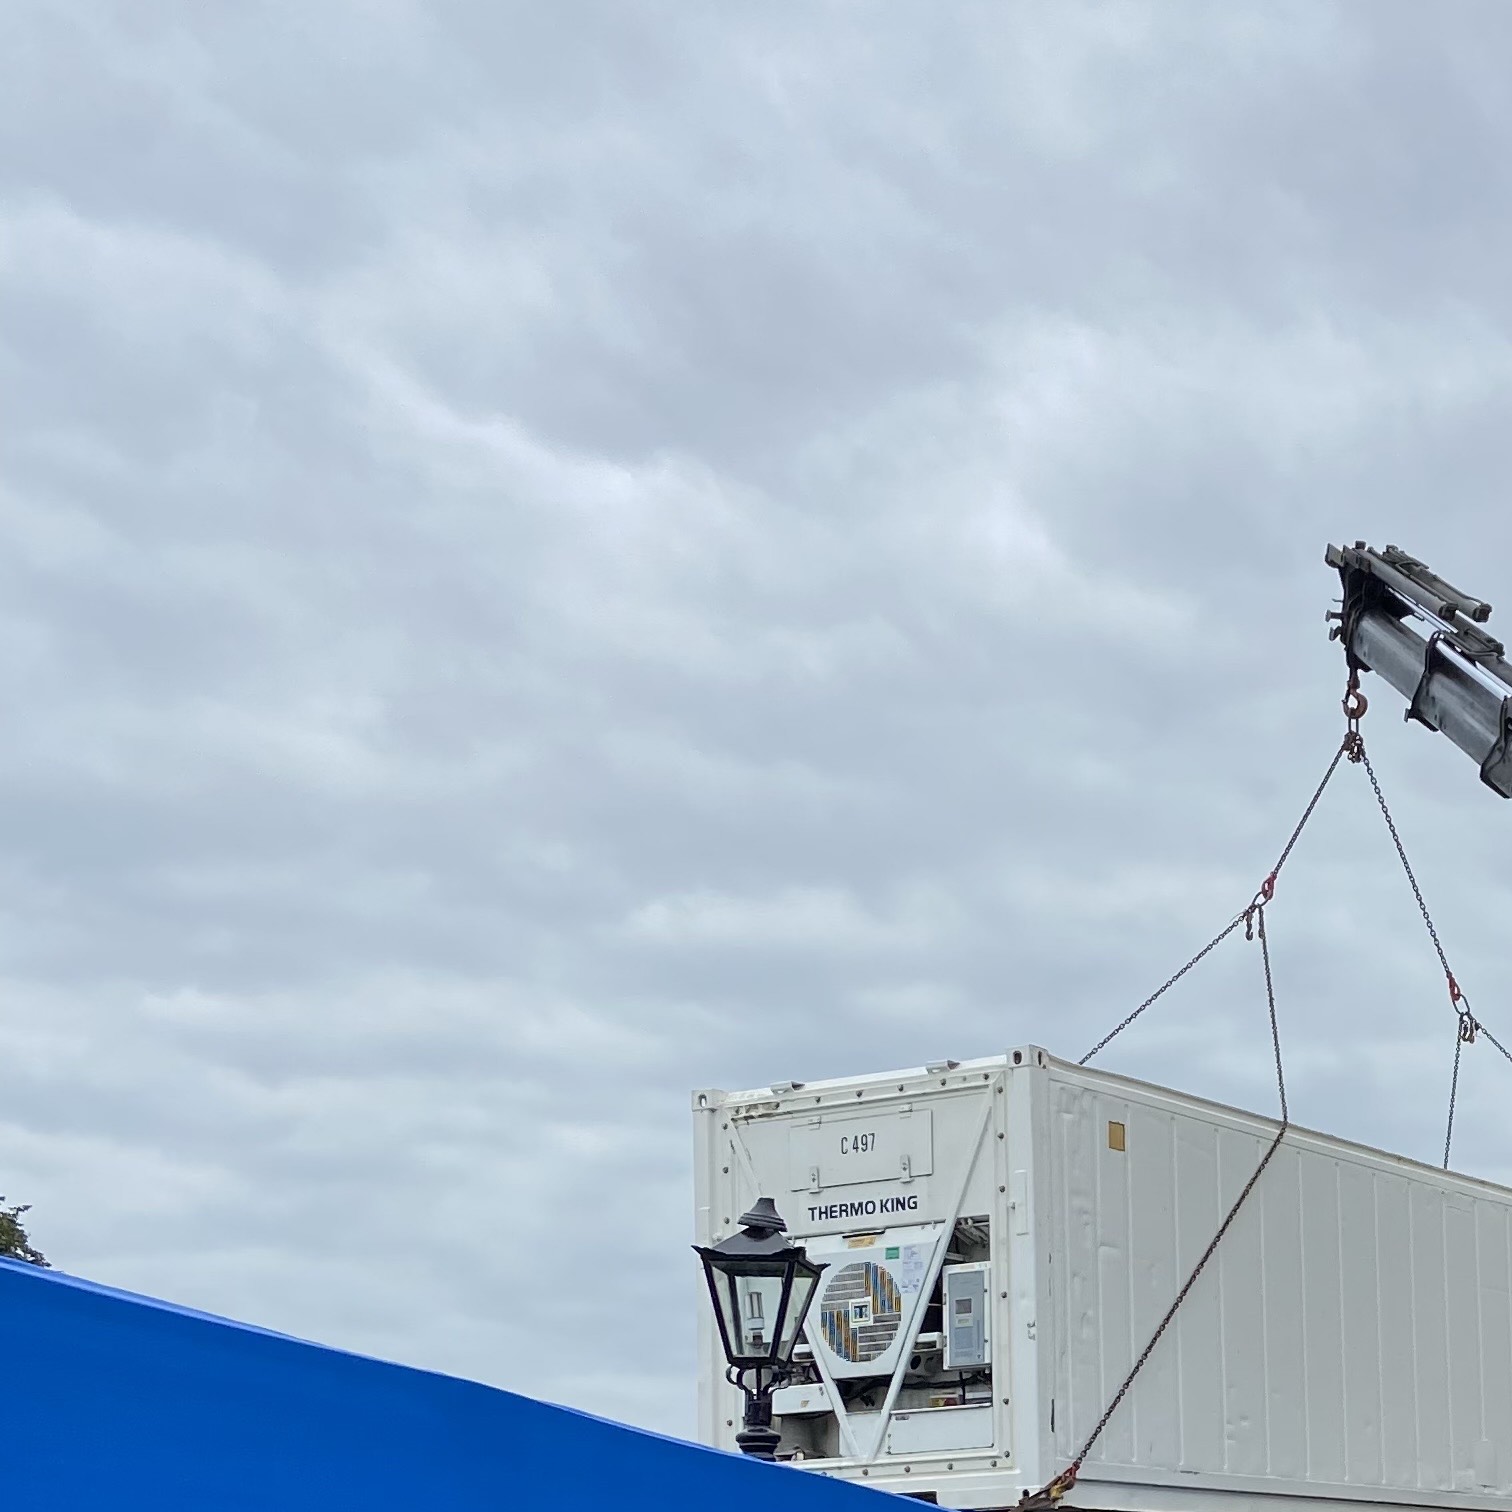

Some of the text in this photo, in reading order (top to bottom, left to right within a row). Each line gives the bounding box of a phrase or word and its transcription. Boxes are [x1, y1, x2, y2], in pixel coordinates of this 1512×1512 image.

[841, 1132, 876, 1155] C 497
[807, 1195, 918, 1221] THERMO KING
